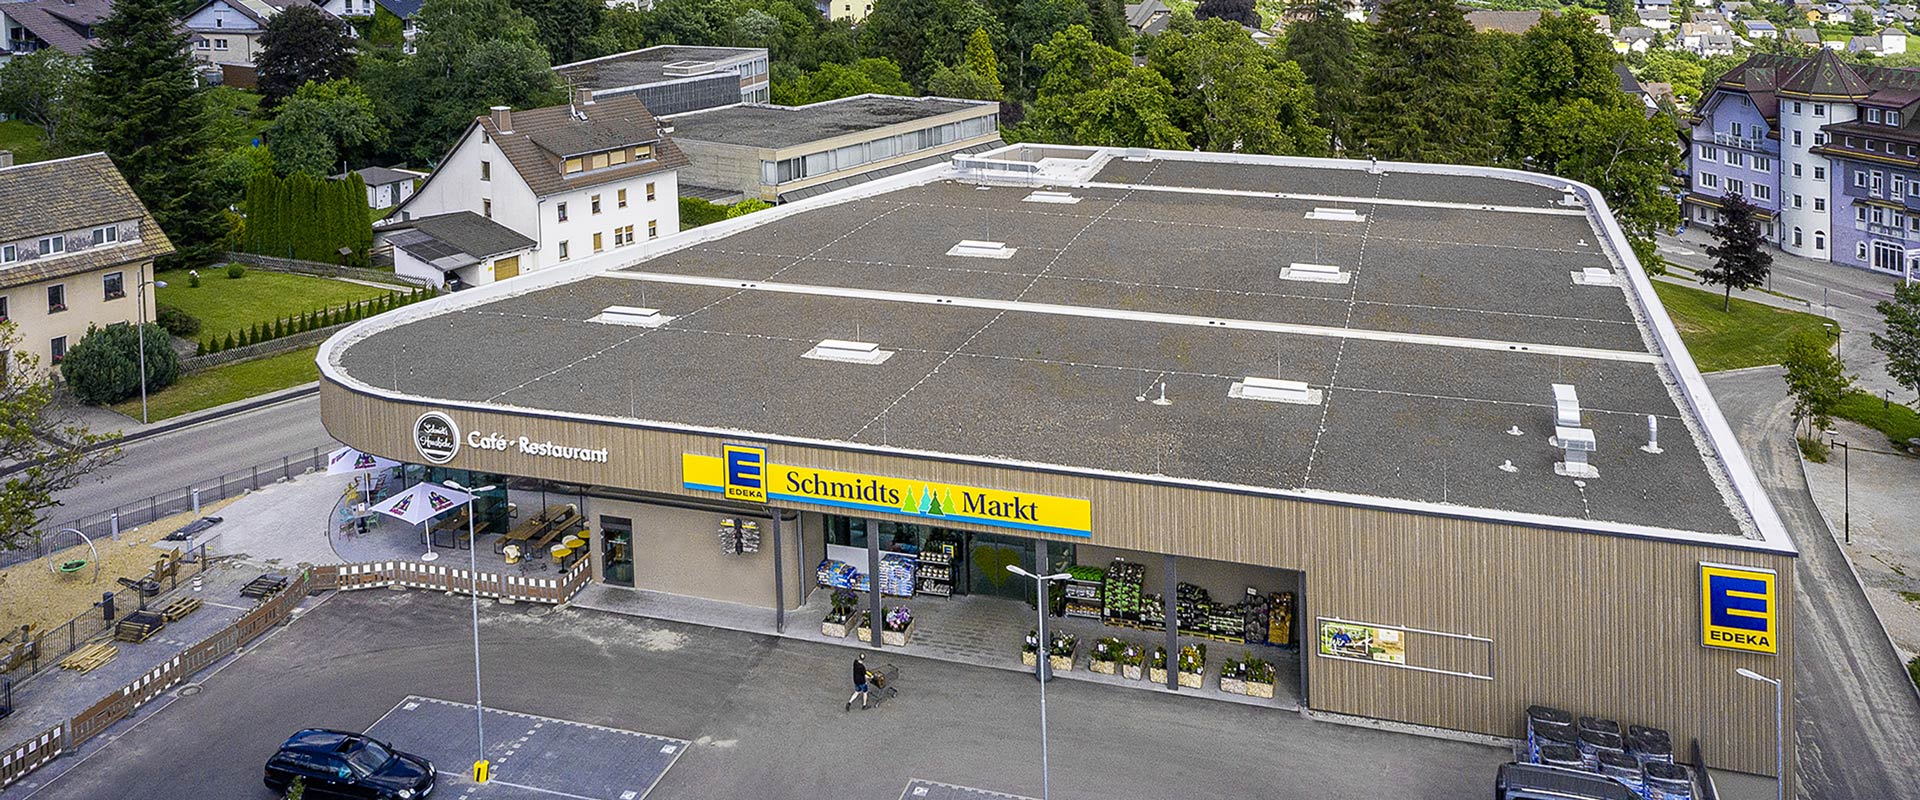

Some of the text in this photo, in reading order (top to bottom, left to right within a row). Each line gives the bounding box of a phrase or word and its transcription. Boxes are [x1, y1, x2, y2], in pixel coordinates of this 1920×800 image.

[467, 430, 609, 463] Café Restaurant
[728, 450, 761, 488] E
[729, 488, 763, 498] EDEKA
[786, 471, 1039, 521] Schmidts Markt
[1710, 574, 1768, 632] E
[1710, 630, 1770, 647] EDEKA
